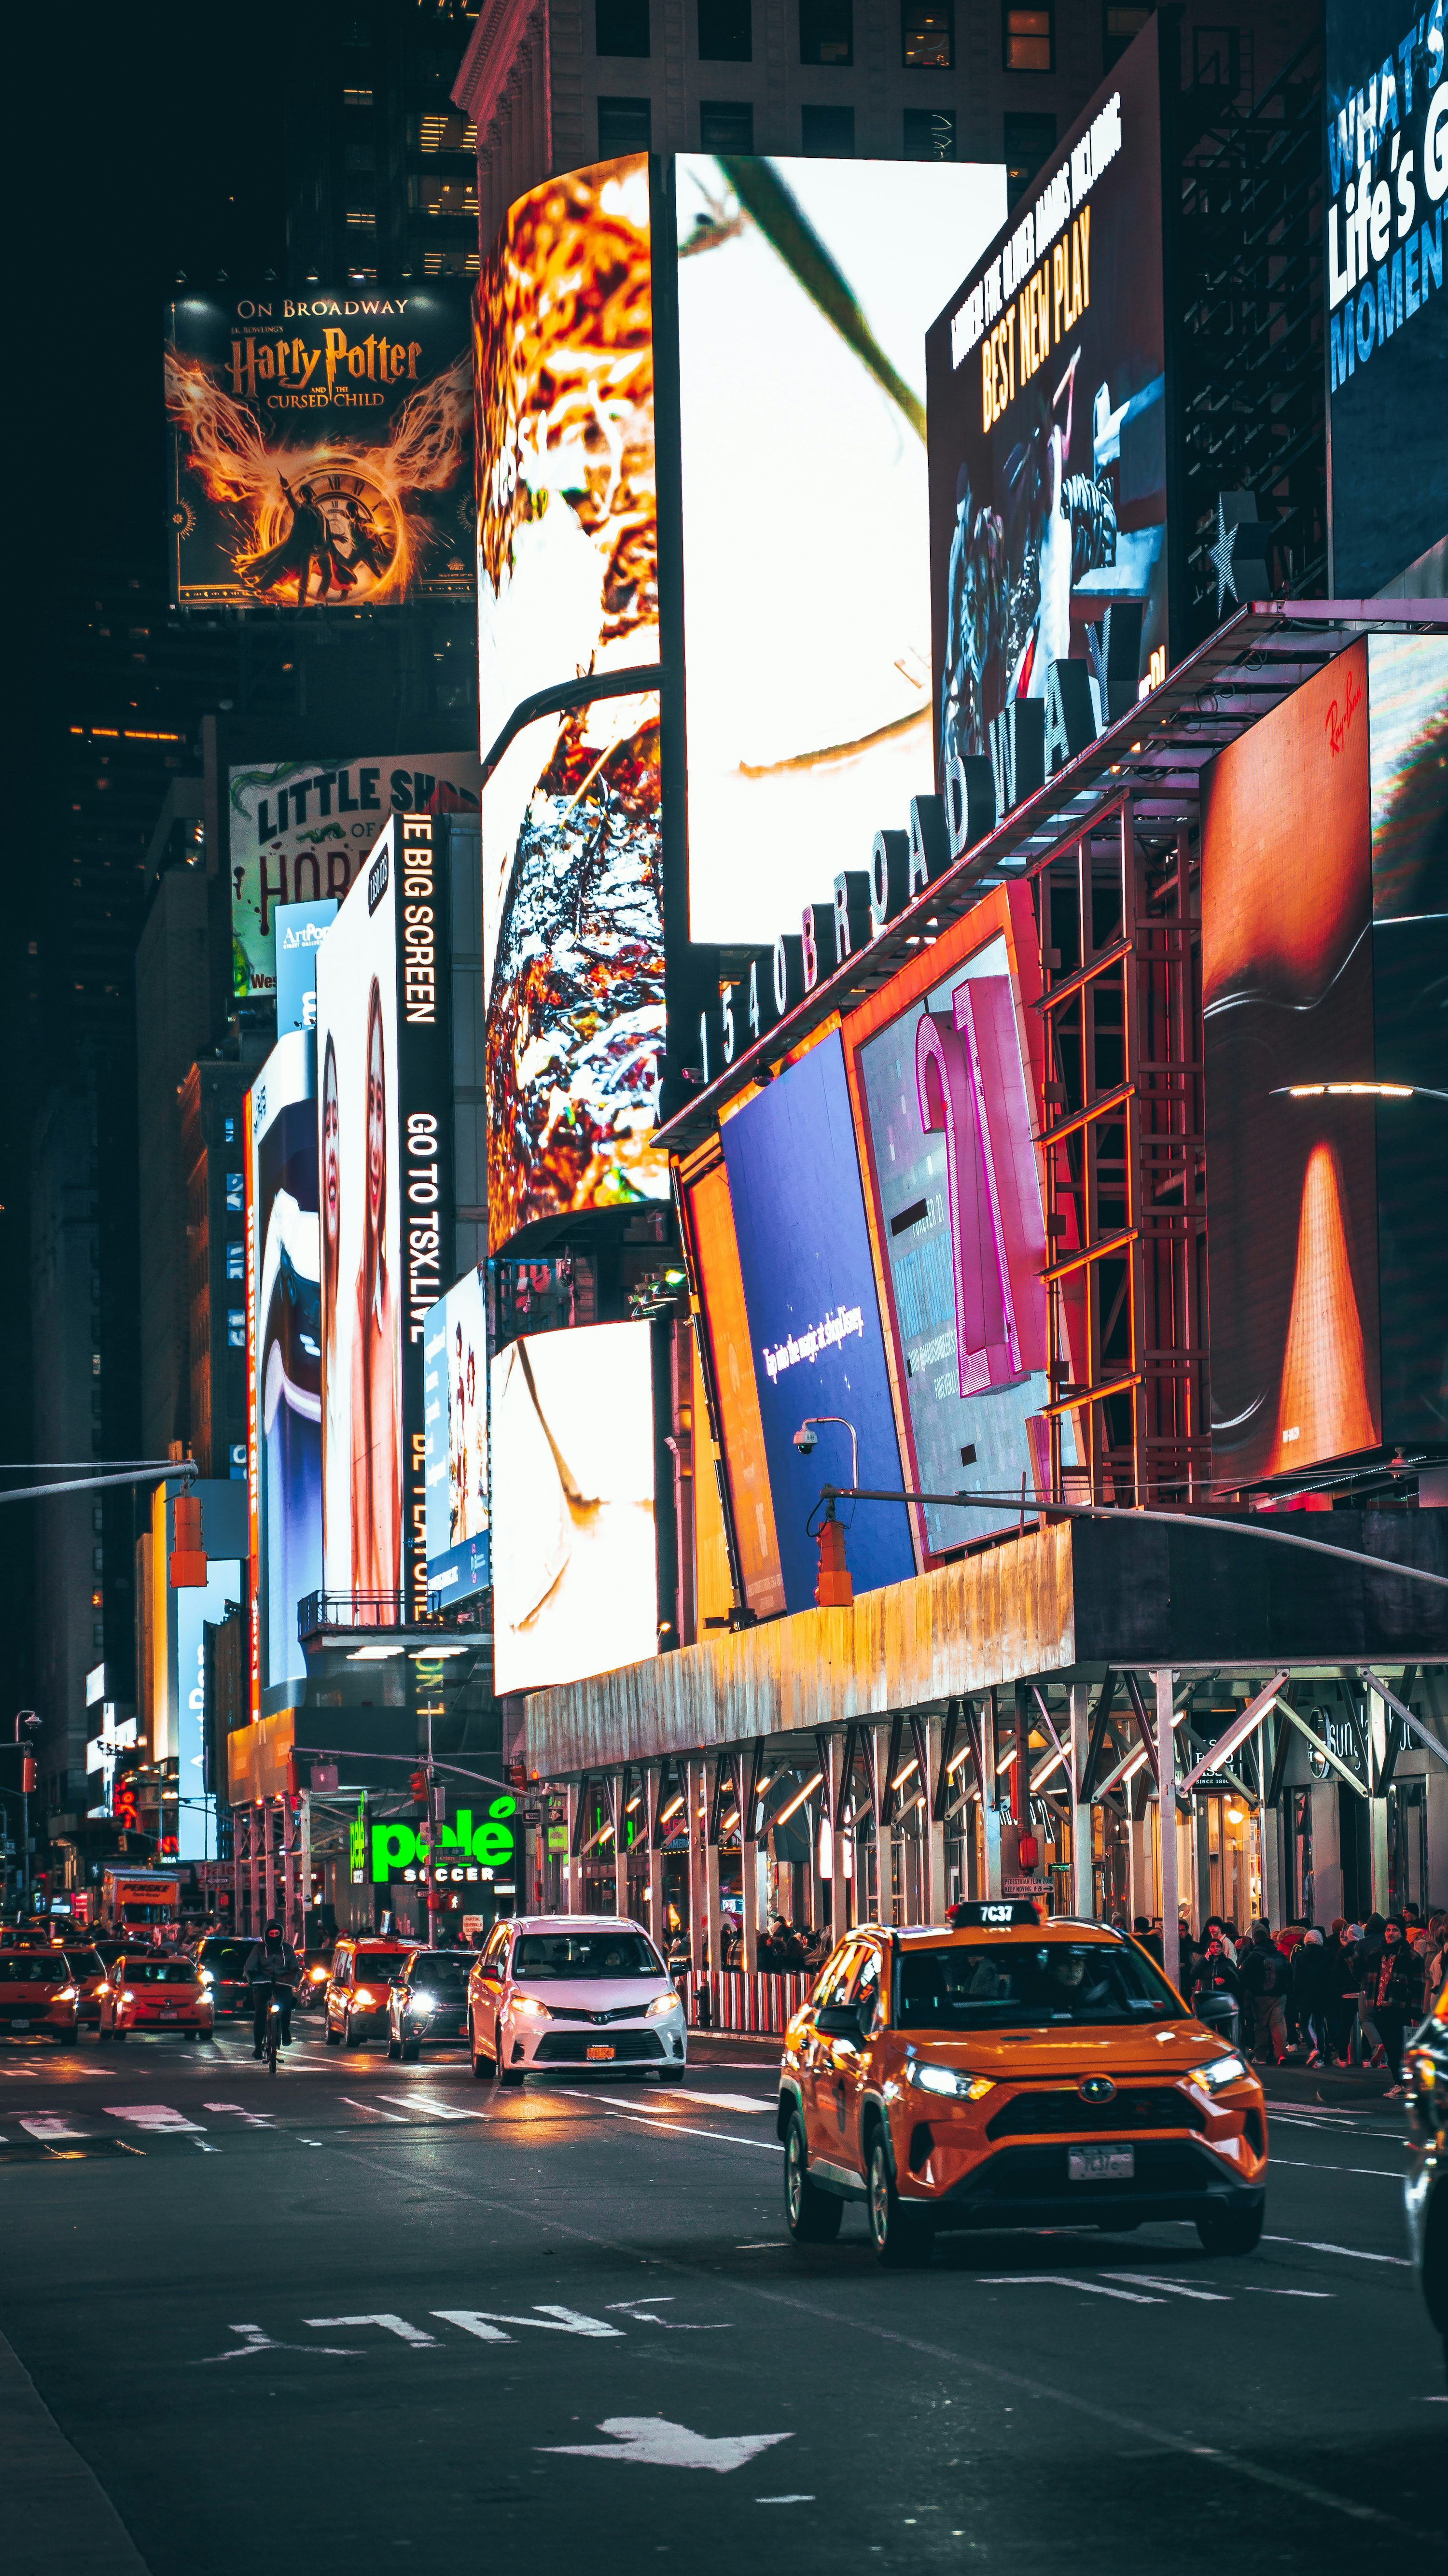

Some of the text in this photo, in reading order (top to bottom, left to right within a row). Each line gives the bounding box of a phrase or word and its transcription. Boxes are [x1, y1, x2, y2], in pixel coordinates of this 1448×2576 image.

[1329, 132, 1416, 310] Life's
[982, 205, 1090, 433] BEST NEW PLAY
[1331, 198, 1448, 394] MOMEN
[225, 327, 422, 402] Harry Potter
[266, 393, 385, 409] CURSED CHILD
[1325, 671, 1362, 758] Ray-Ban
[258, 768, 381, 844] LITTLE
[351, 822, 375, 839] OF
[403, 848, 434, 897] BIG
[699, 607, 1111, 1083] 1540 BROADWAY
[404, 905, 436, 1023] SCREEN
[406, 1112, 438, 1157] GO
[407, 1162, 439, 1204] TO
[916, 981, 1022, 1398] 21
[935, 1193, 945, 1223] 21
[123, 1883, 170, 1892] PENSKE
[980, 1905, 1013, 1921] 7C37
